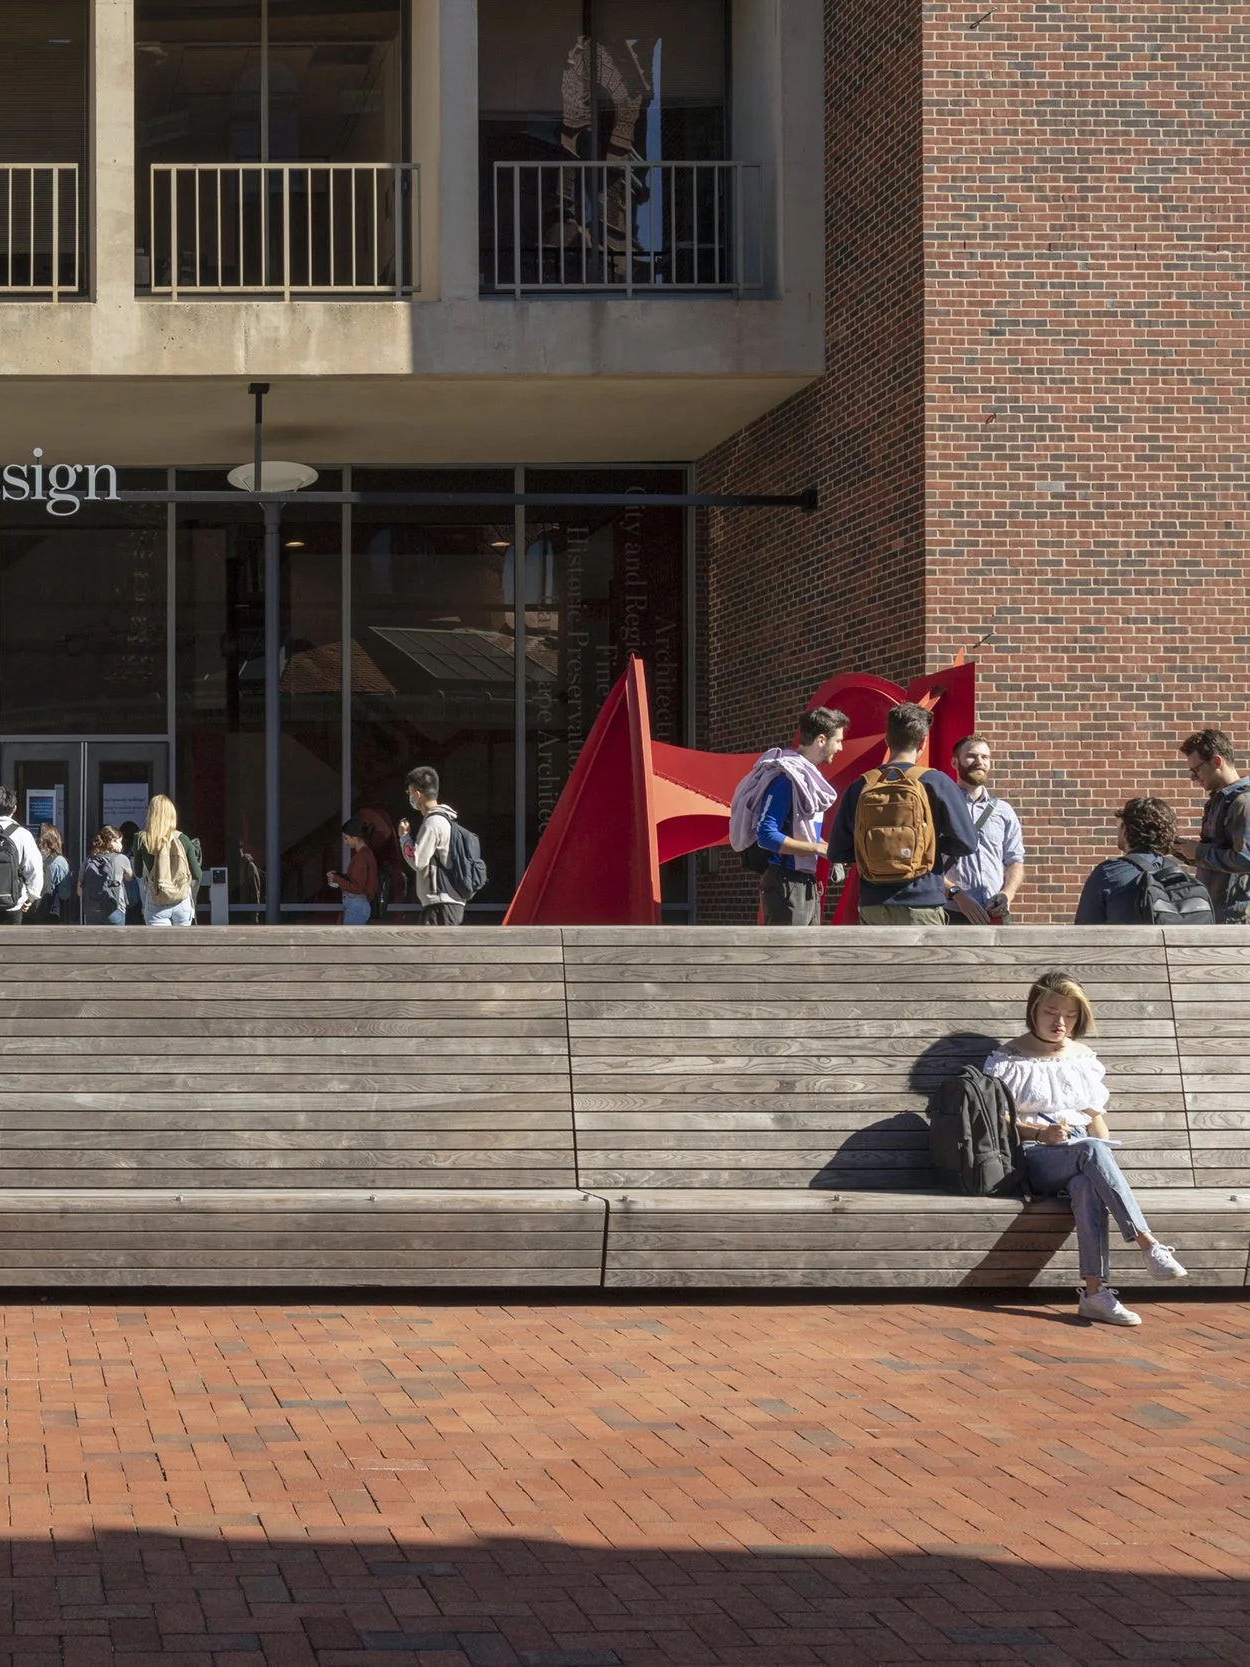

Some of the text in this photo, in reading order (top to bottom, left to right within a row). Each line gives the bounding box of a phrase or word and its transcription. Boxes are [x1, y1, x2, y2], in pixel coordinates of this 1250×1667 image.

[567, 526, 590, 622] Historic
[625, 541, 649, 586] and
[596, 643, 618, 696] Fine
